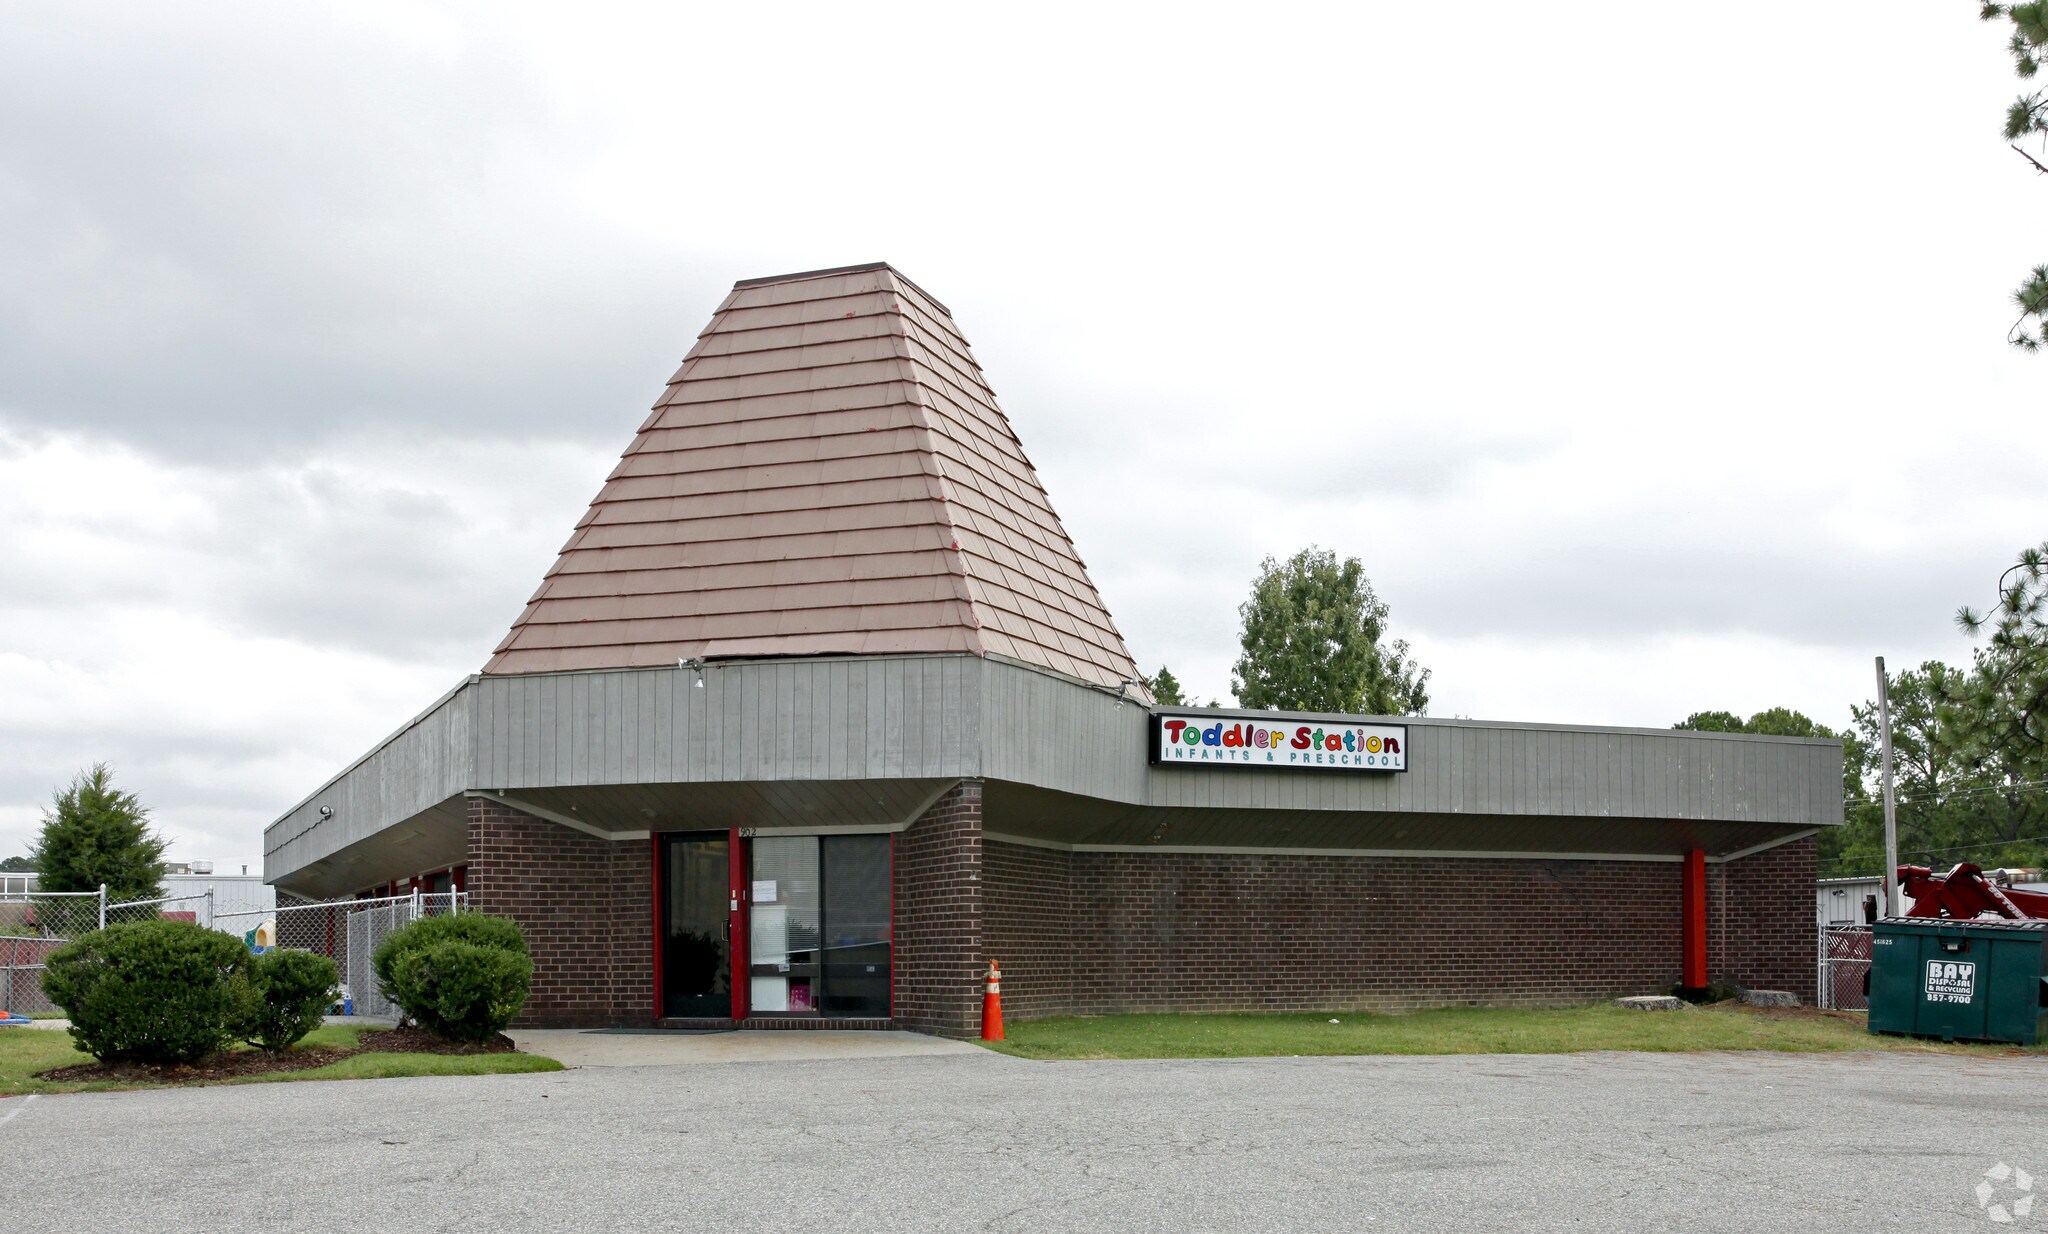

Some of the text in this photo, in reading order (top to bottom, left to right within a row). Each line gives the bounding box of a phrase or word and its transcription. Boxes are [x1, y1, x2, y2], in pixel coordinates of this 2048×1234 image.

[1164, 720, 1401, 754] Toddler Station
[1165, 747, 1401, 767] INFANTS & PRESCHOOL
[1929, 962, 1973, 980] BAY
[1928, 977, 1971, 987] DISPOSAL
[1935, 985, 1971, 994] RECYCLING
[1927, 993, 1971, 1004] 857-9700
